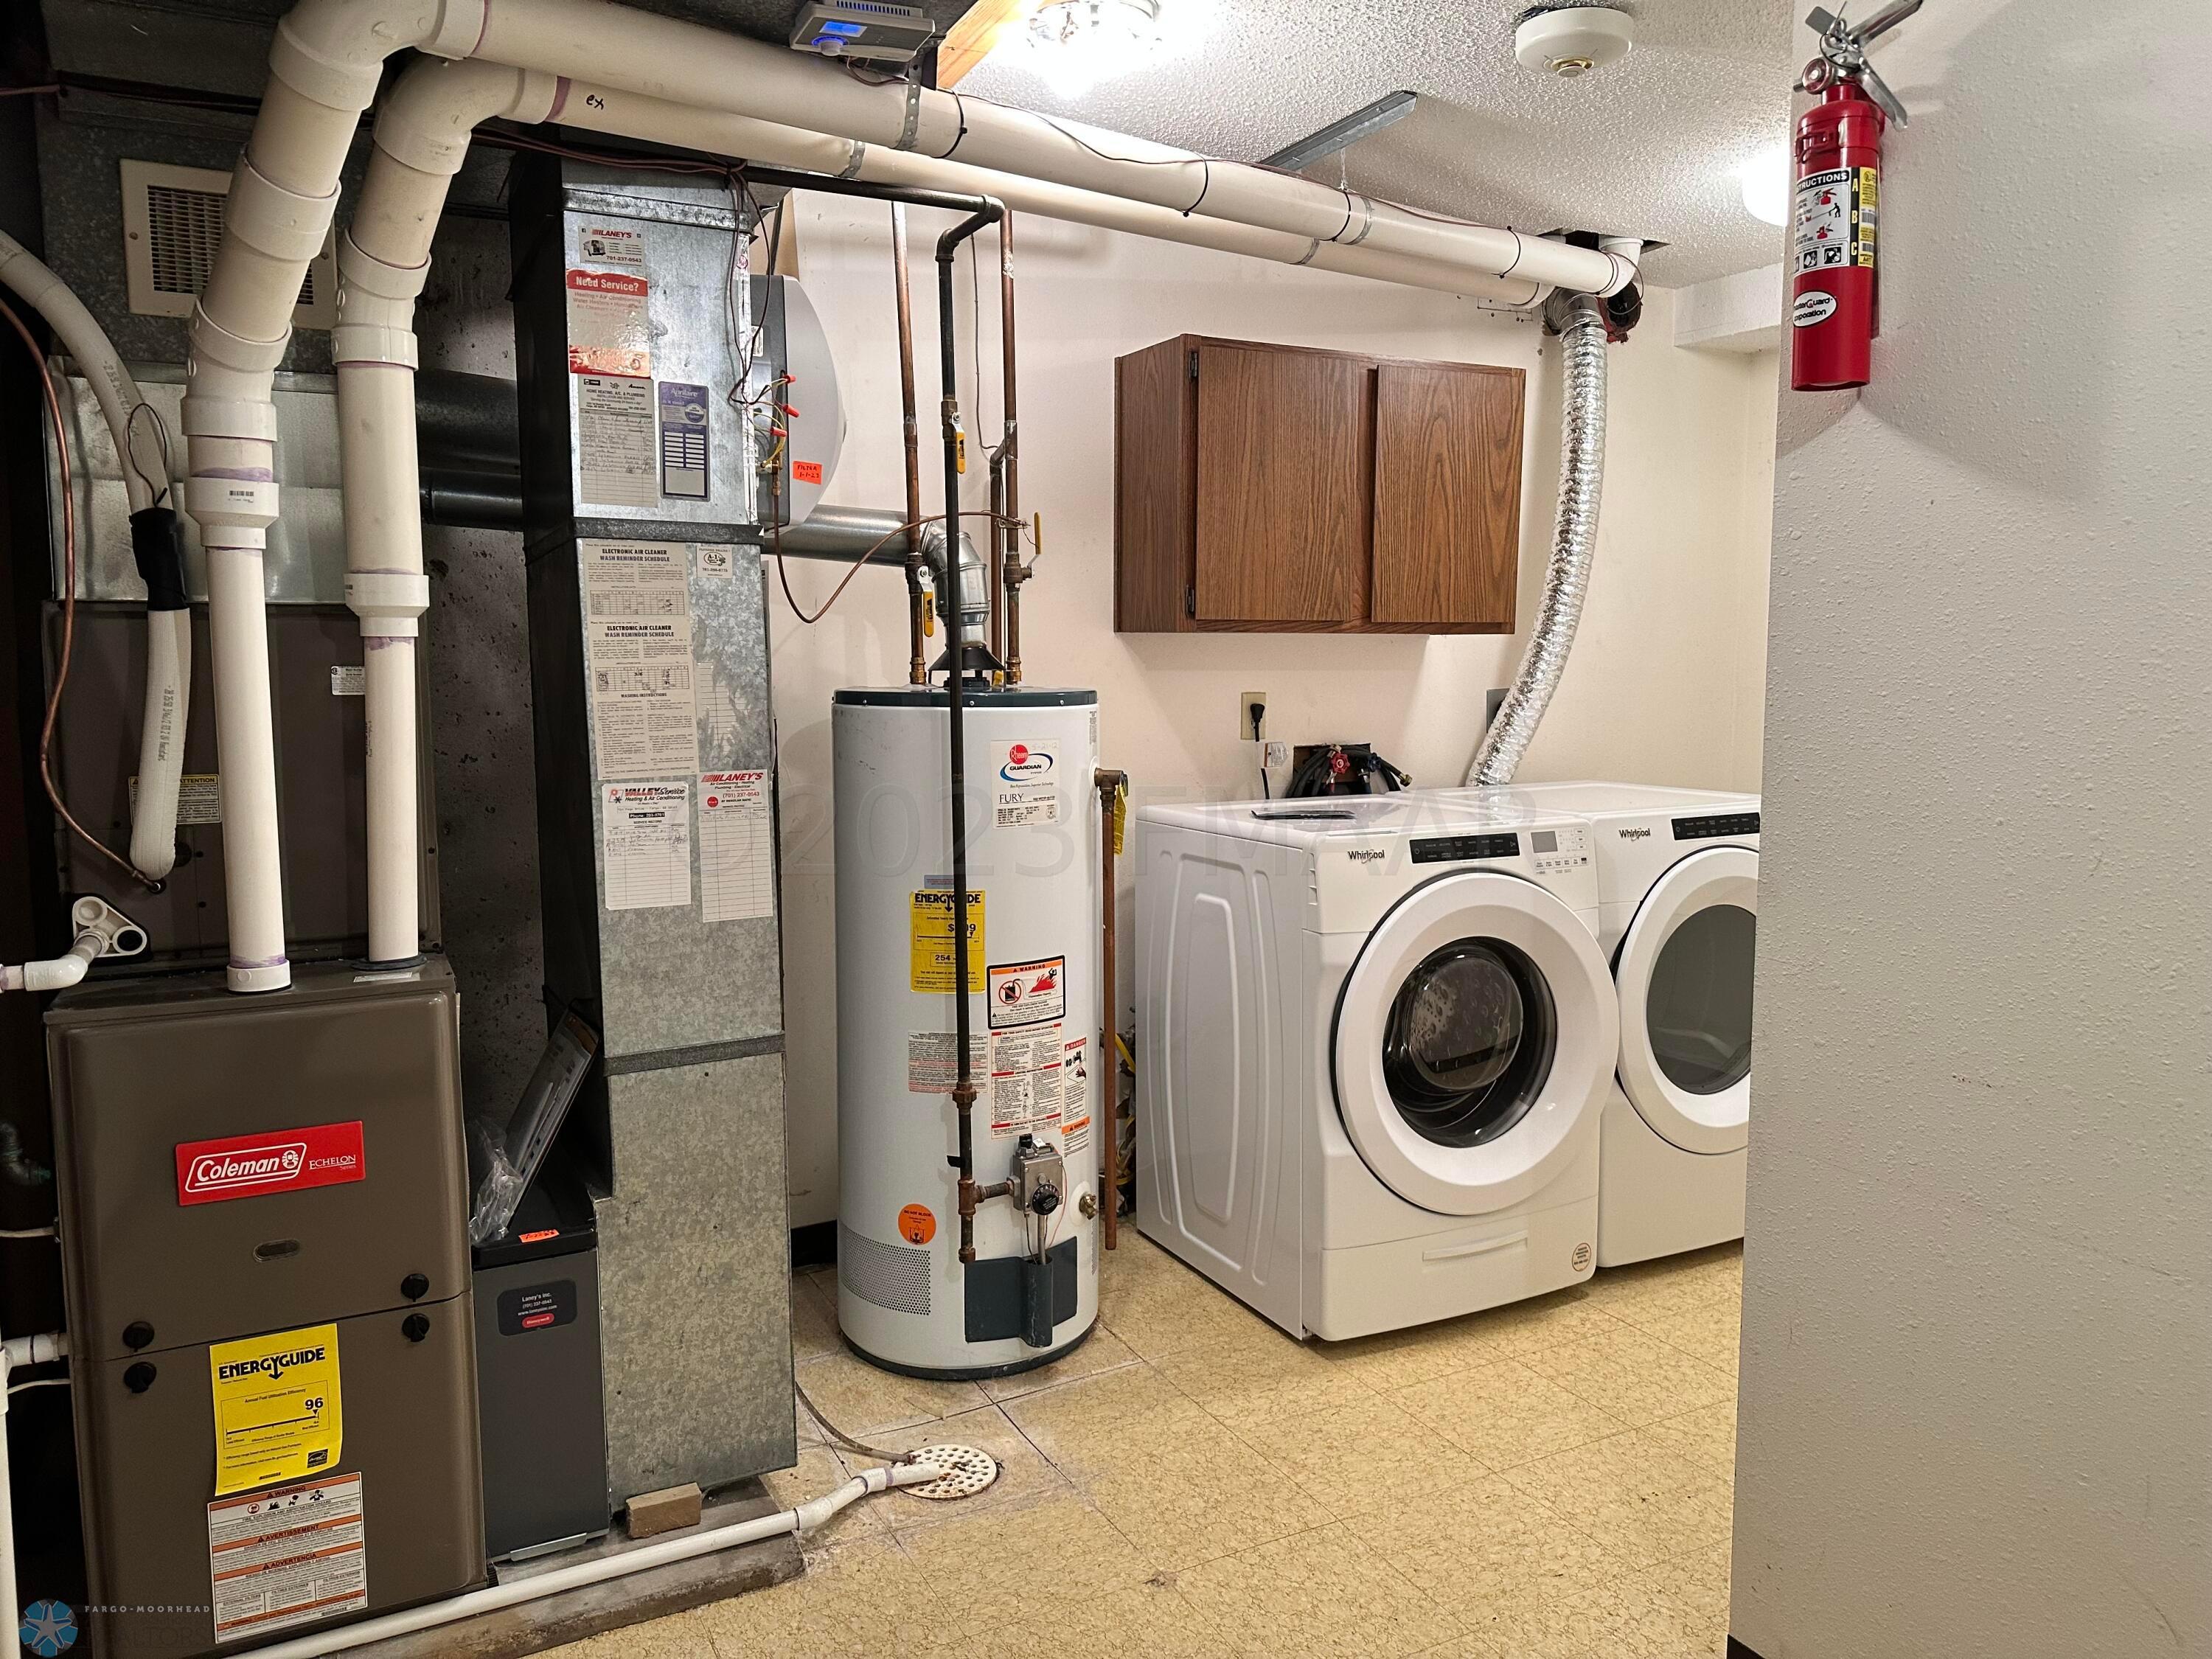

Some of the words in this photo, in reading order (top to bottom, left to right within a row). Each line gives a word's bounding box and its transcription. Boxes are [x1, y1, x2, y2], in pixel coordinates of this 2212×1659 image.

[586, 94, 604, 110] ex
[1796, 171, 1848, 192] TRUCTIONS
[1852, 178, 1858, 192] A
[1851, 210, 1858, 223] B
[1851, 242, 1857, 255] C
[576, 276, 599, 288] Need
[601, 279, 639, 291] Service?
[716, 772, 764, 782] LANEY'S
[658, 787, 685, 796] Service
[999, 793, 1024, 803] FURY
[1618, 827, 1651, 841] Whirlpool
[1348, 849, 1385, 862] Whirlpool
[1070, 1038, 1086, 1048] DANGER
[197, 1157, 280, 1182] Coleman
[308, 1154, 356, 1170] ECHELON
[218, 1347, 326, 1380] ENERGYGUIDE
[305, 1397, 324, 1411] 96
[274, 1485, 306, 1497] WARNING
[265, 1524, 319, 1541] AVERTISSEMENT
[271, 1553, 317, 1568] ADVERTENCIA
